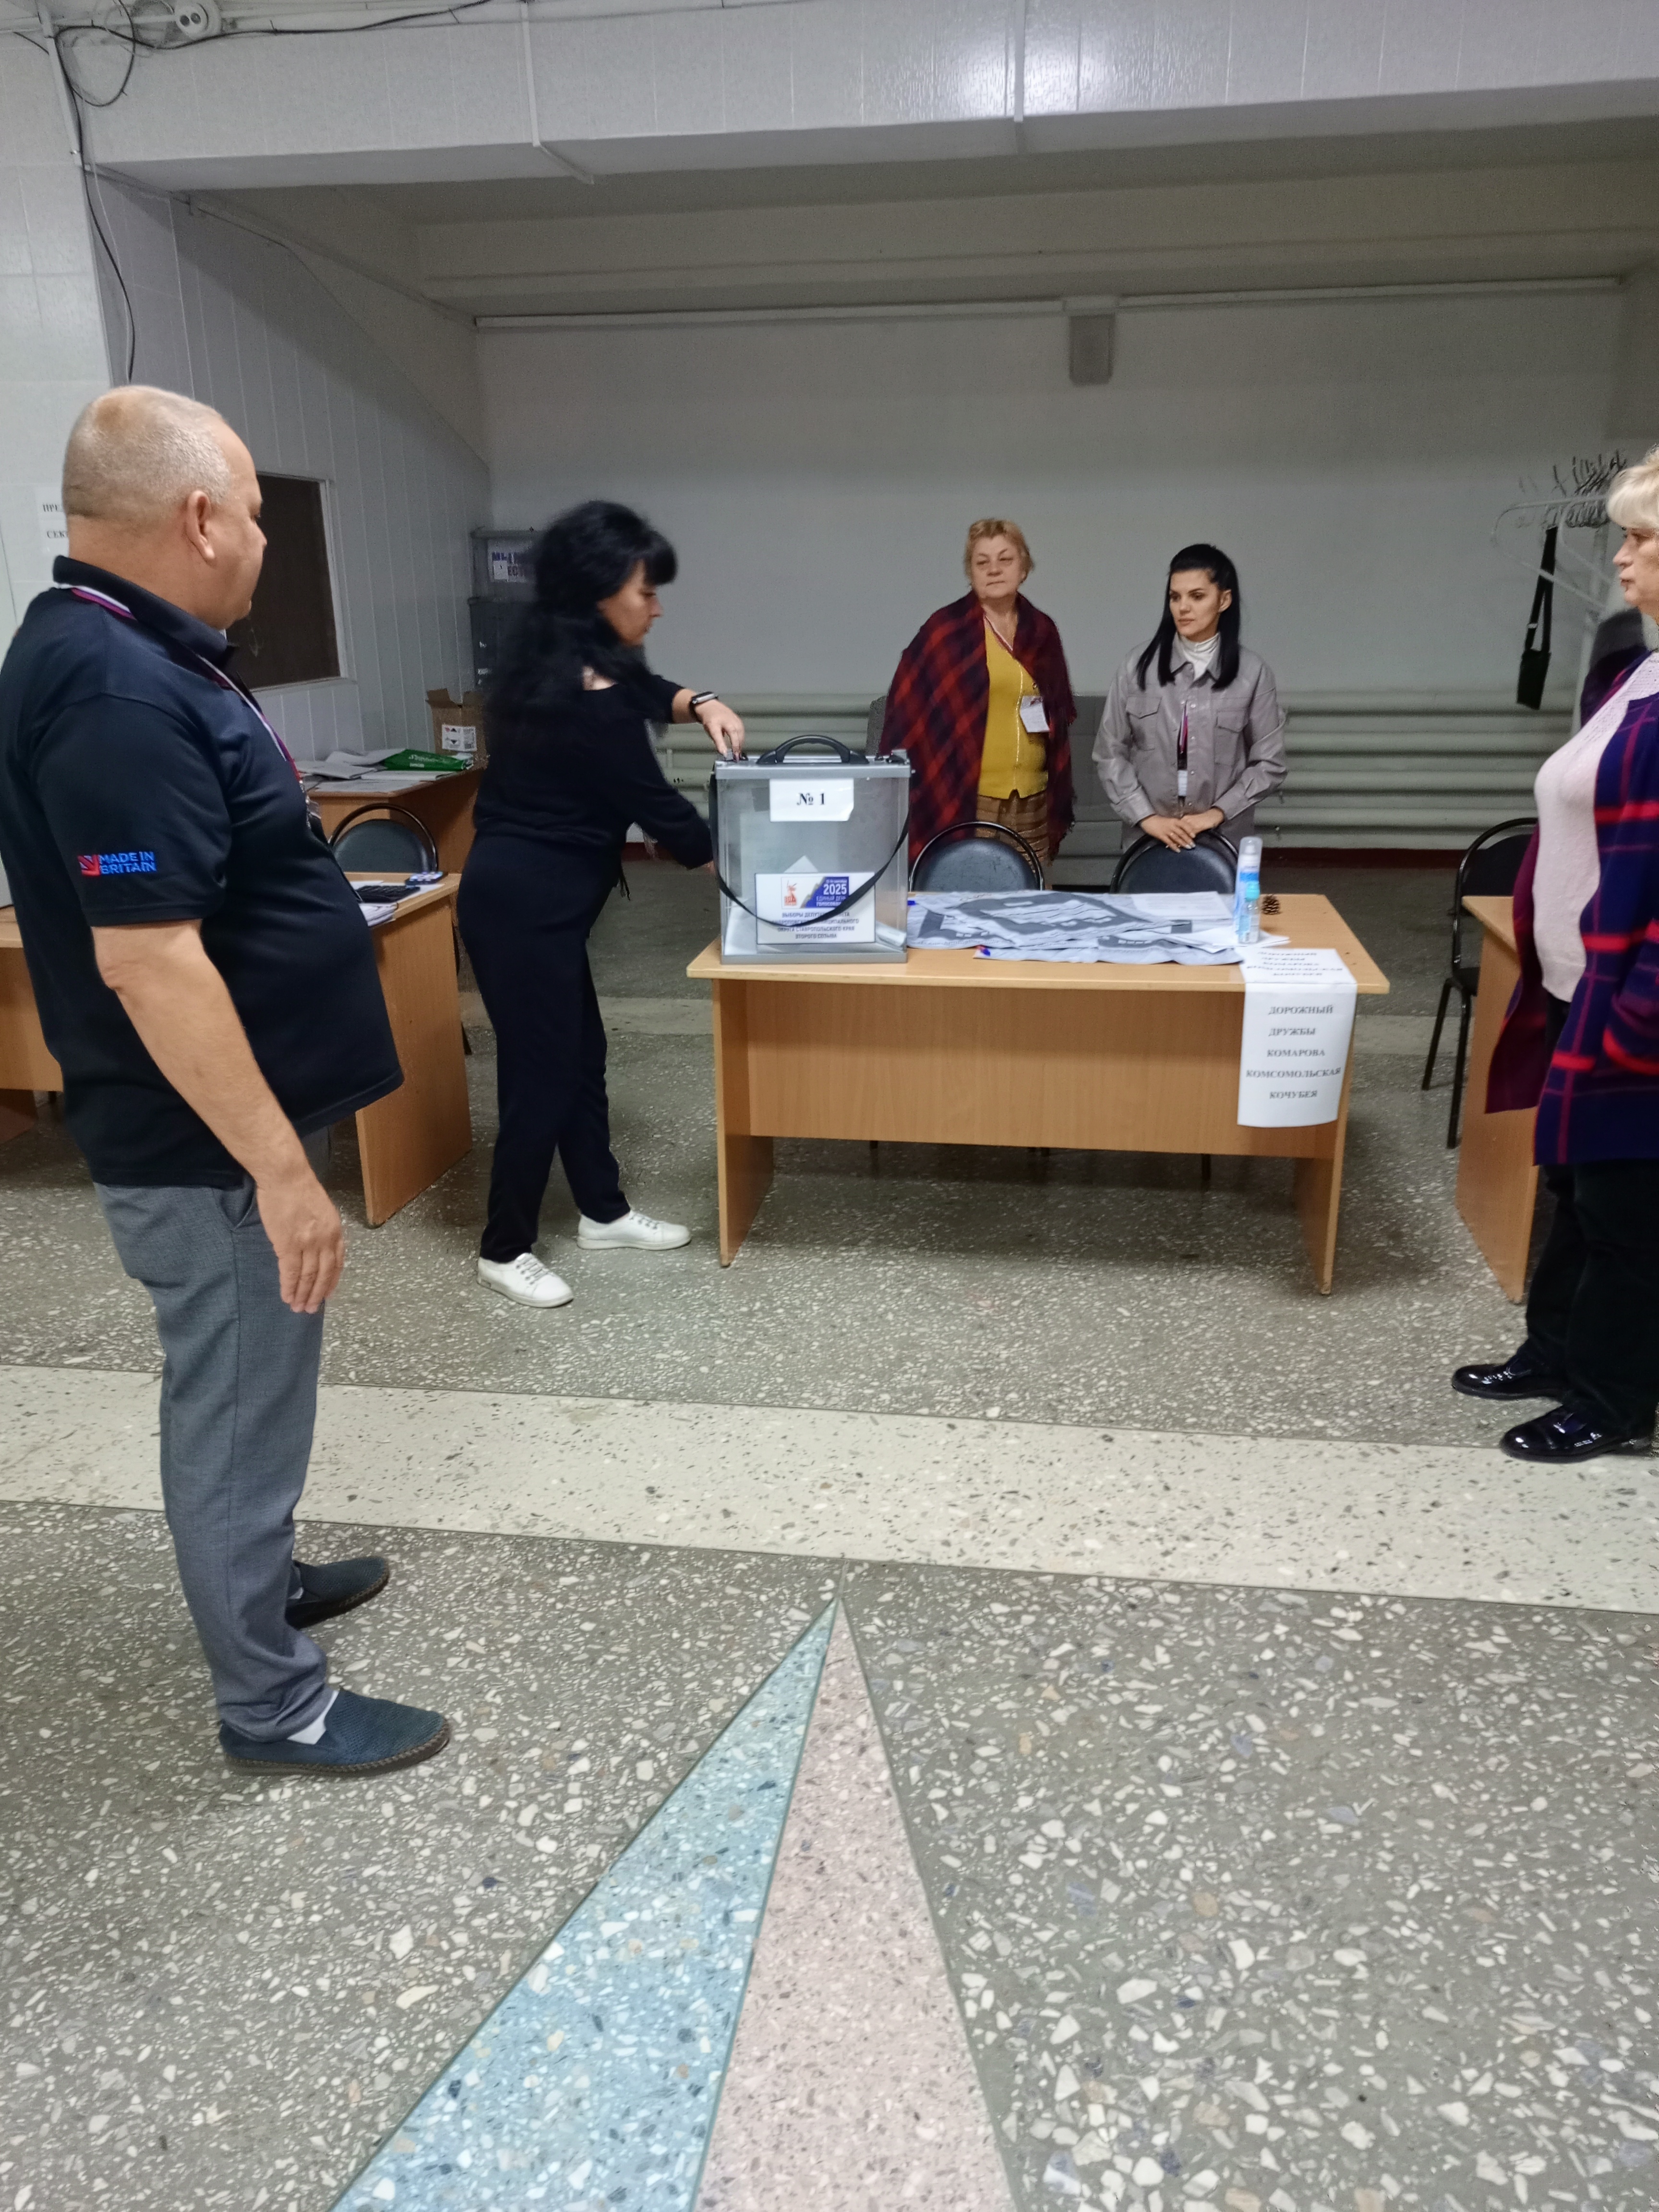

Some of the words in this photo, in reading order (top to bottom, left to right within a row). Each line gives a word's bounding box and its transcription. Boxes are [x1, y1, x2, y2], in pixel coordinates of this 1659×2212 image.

[797, 793, 813, 805] №
[820, 793, 825, 805] 1
[98, 852, 139, 864] MADE
[139, 851, 154, 861] IN
[99, 862, 156, 874] BRITAIN
[823, 884, 847, 895] 2025
[1268, 1004, 1334, 1015] ДОРОЖНЫЙ
[1268, 1028, 1316, 1036] ДРУЖБЫ
[1267, 1049, 1325, 1058] КОМАРОВА
[1246, 1067, 1341, 1078] КОМСОМОЛЬСКАЯ
[1269, 1090, 1318, 1099] КОЧУБЕЯ
